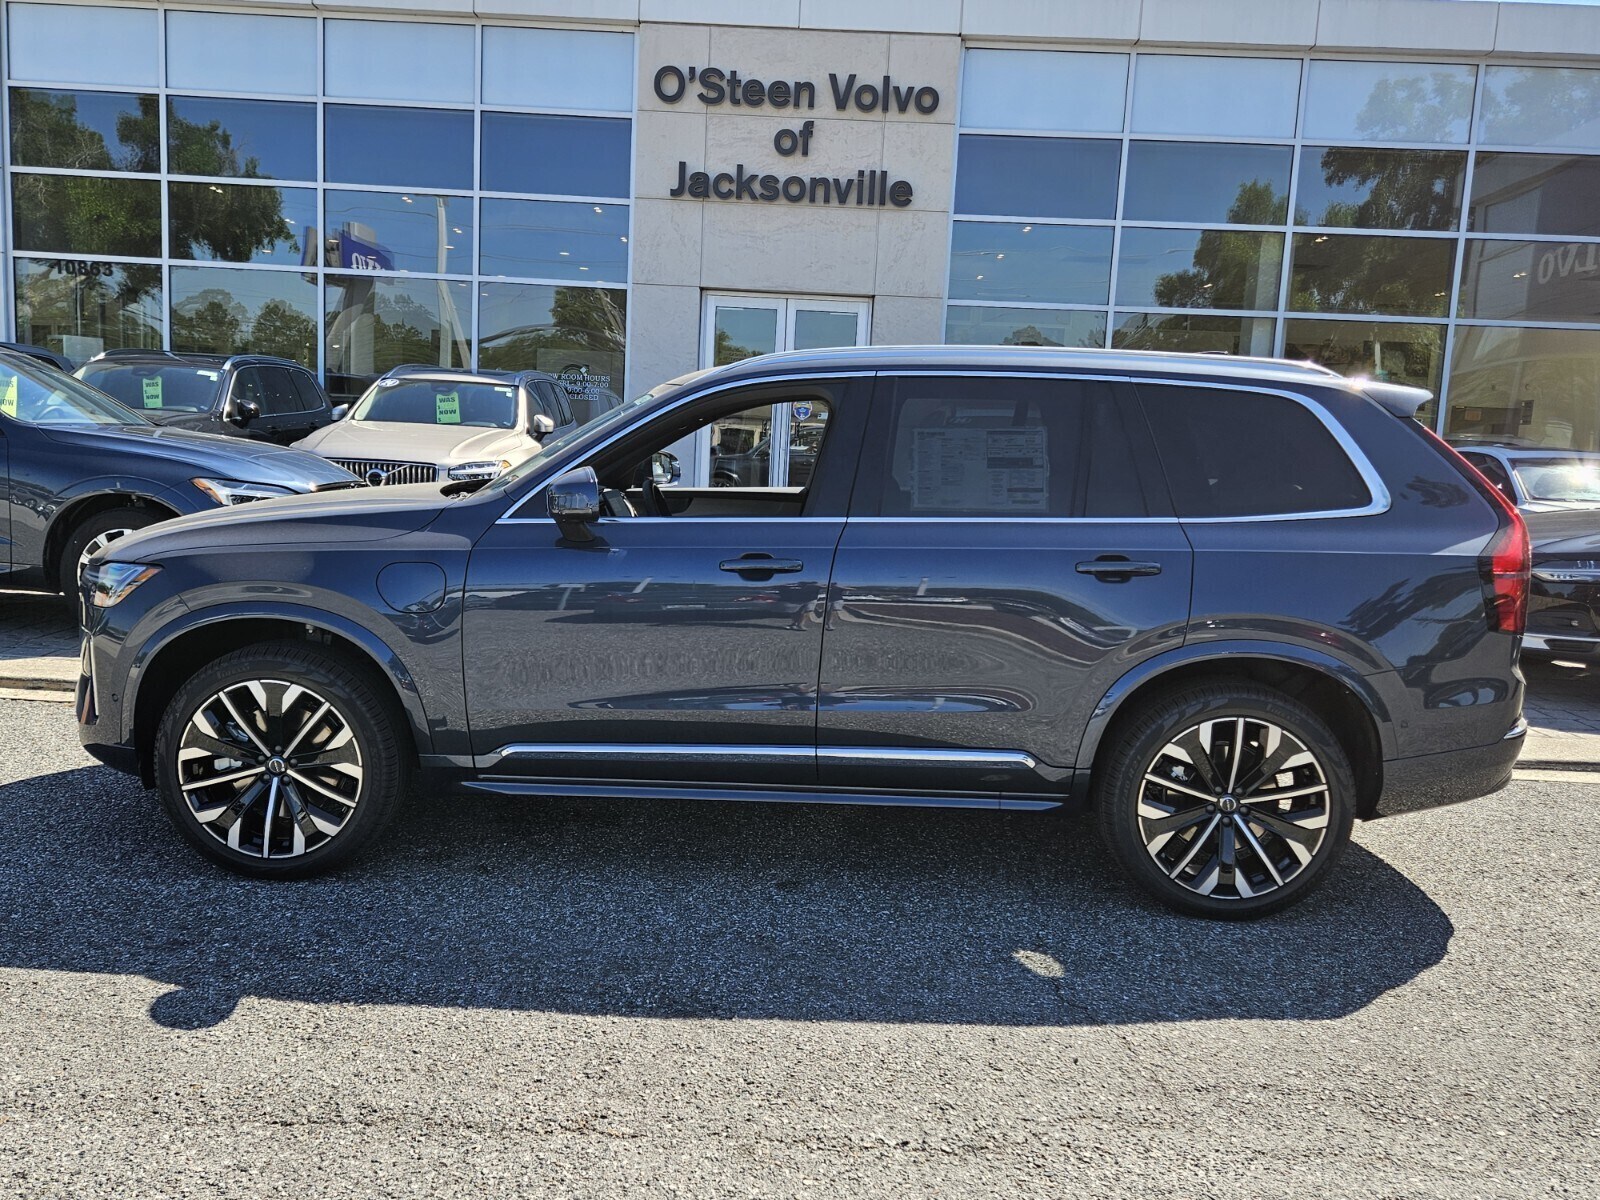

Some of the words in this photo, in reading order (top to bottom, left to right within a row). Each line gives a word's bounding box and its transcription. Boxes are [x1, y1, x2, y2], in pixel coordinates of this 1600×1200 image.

[653, 65, 816, 110] O'Steen
[828, 73, 940, 115] Volvo
[773, 120, 815, 157] of
[669, 161, 913, 208] Jacksonville
[57, 260, 113, 276] 10863
[584, 374, 611, 382] HOURS
